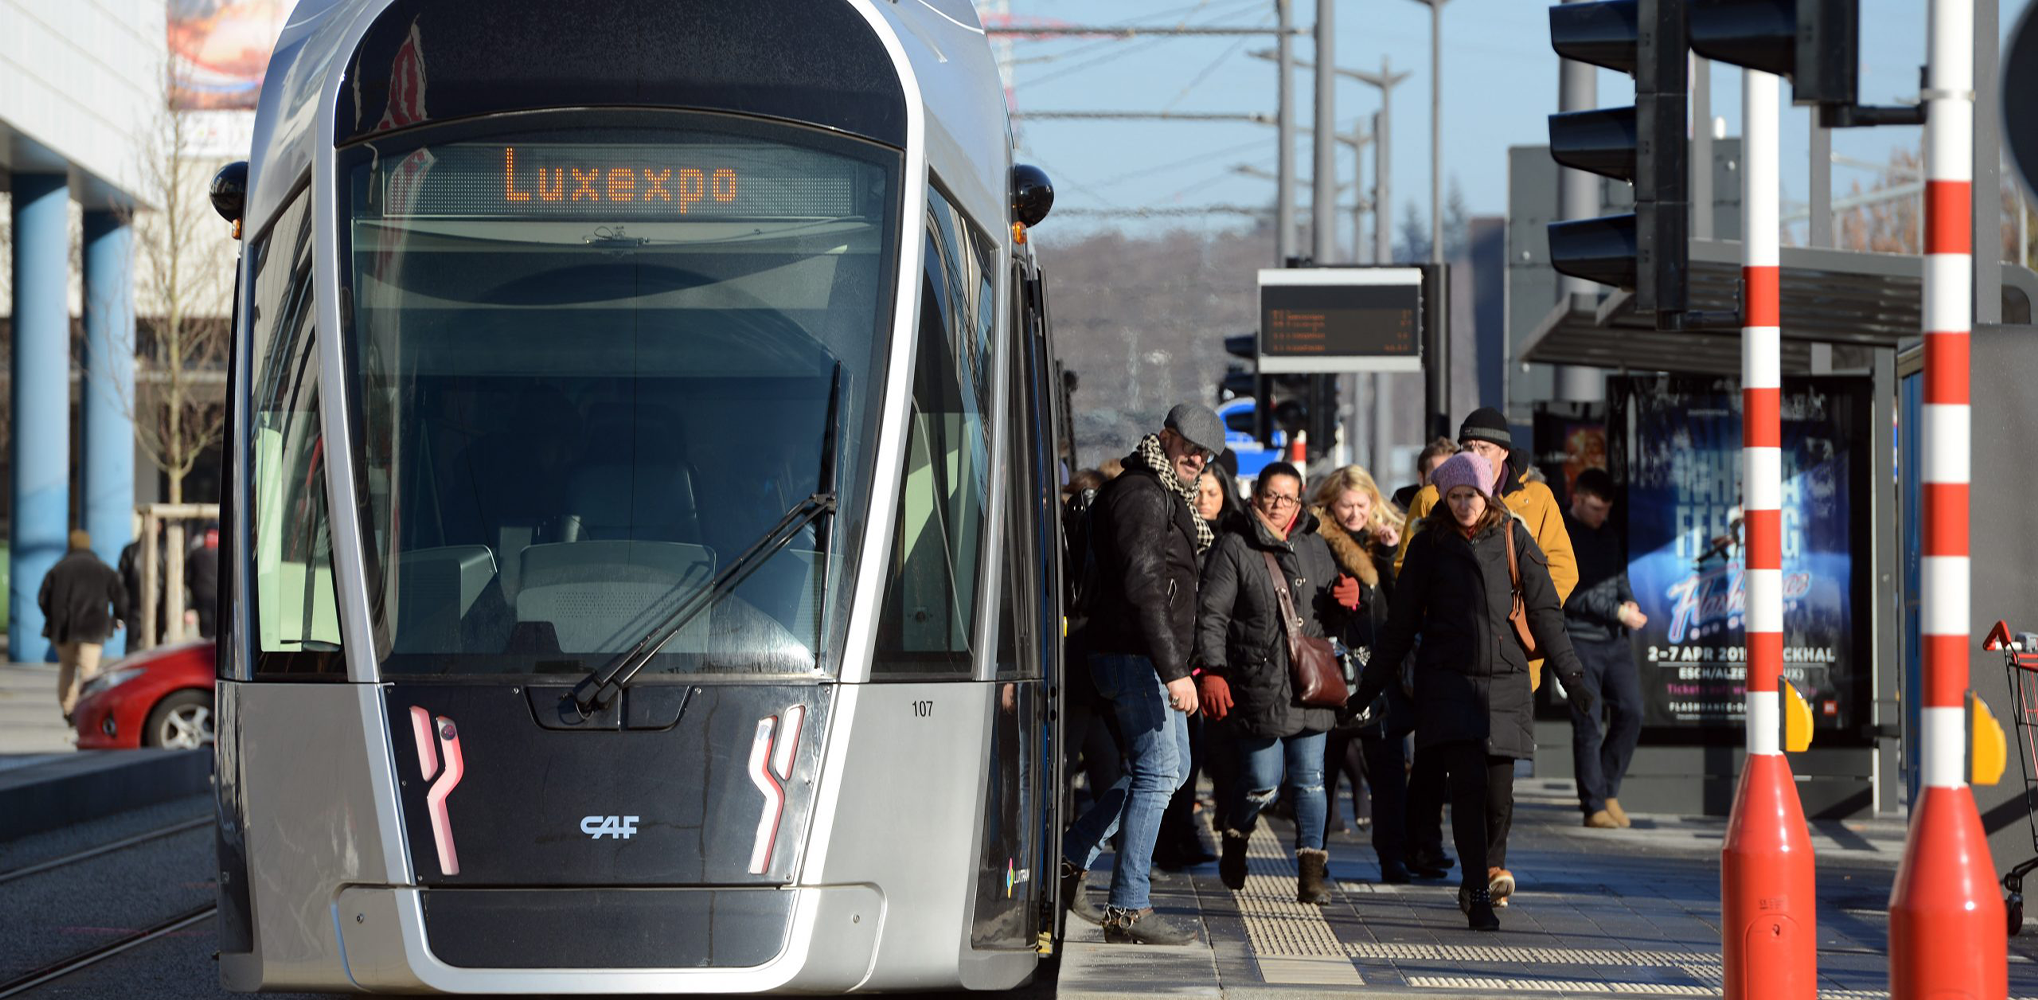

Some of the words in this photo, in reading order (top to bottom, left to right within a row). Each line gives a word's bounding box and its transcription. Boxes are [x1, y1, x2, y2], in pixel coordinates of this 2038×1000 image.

[506, 147, 736, 214] Luxexpo
[1648, 646, 1679, 662] 2-7
[1681, 646, 1713, 662] APR
[1718, 646, 1747, 662] 201
[1783, 647, 1836, 663] CKHAL
[1679, 667, 1747, 680] ESCH/ALZE
[1783, 668, 1805, 681] UX)
[912, 700, 934, 717] 107
[580, 815, 640, 840] CAF
